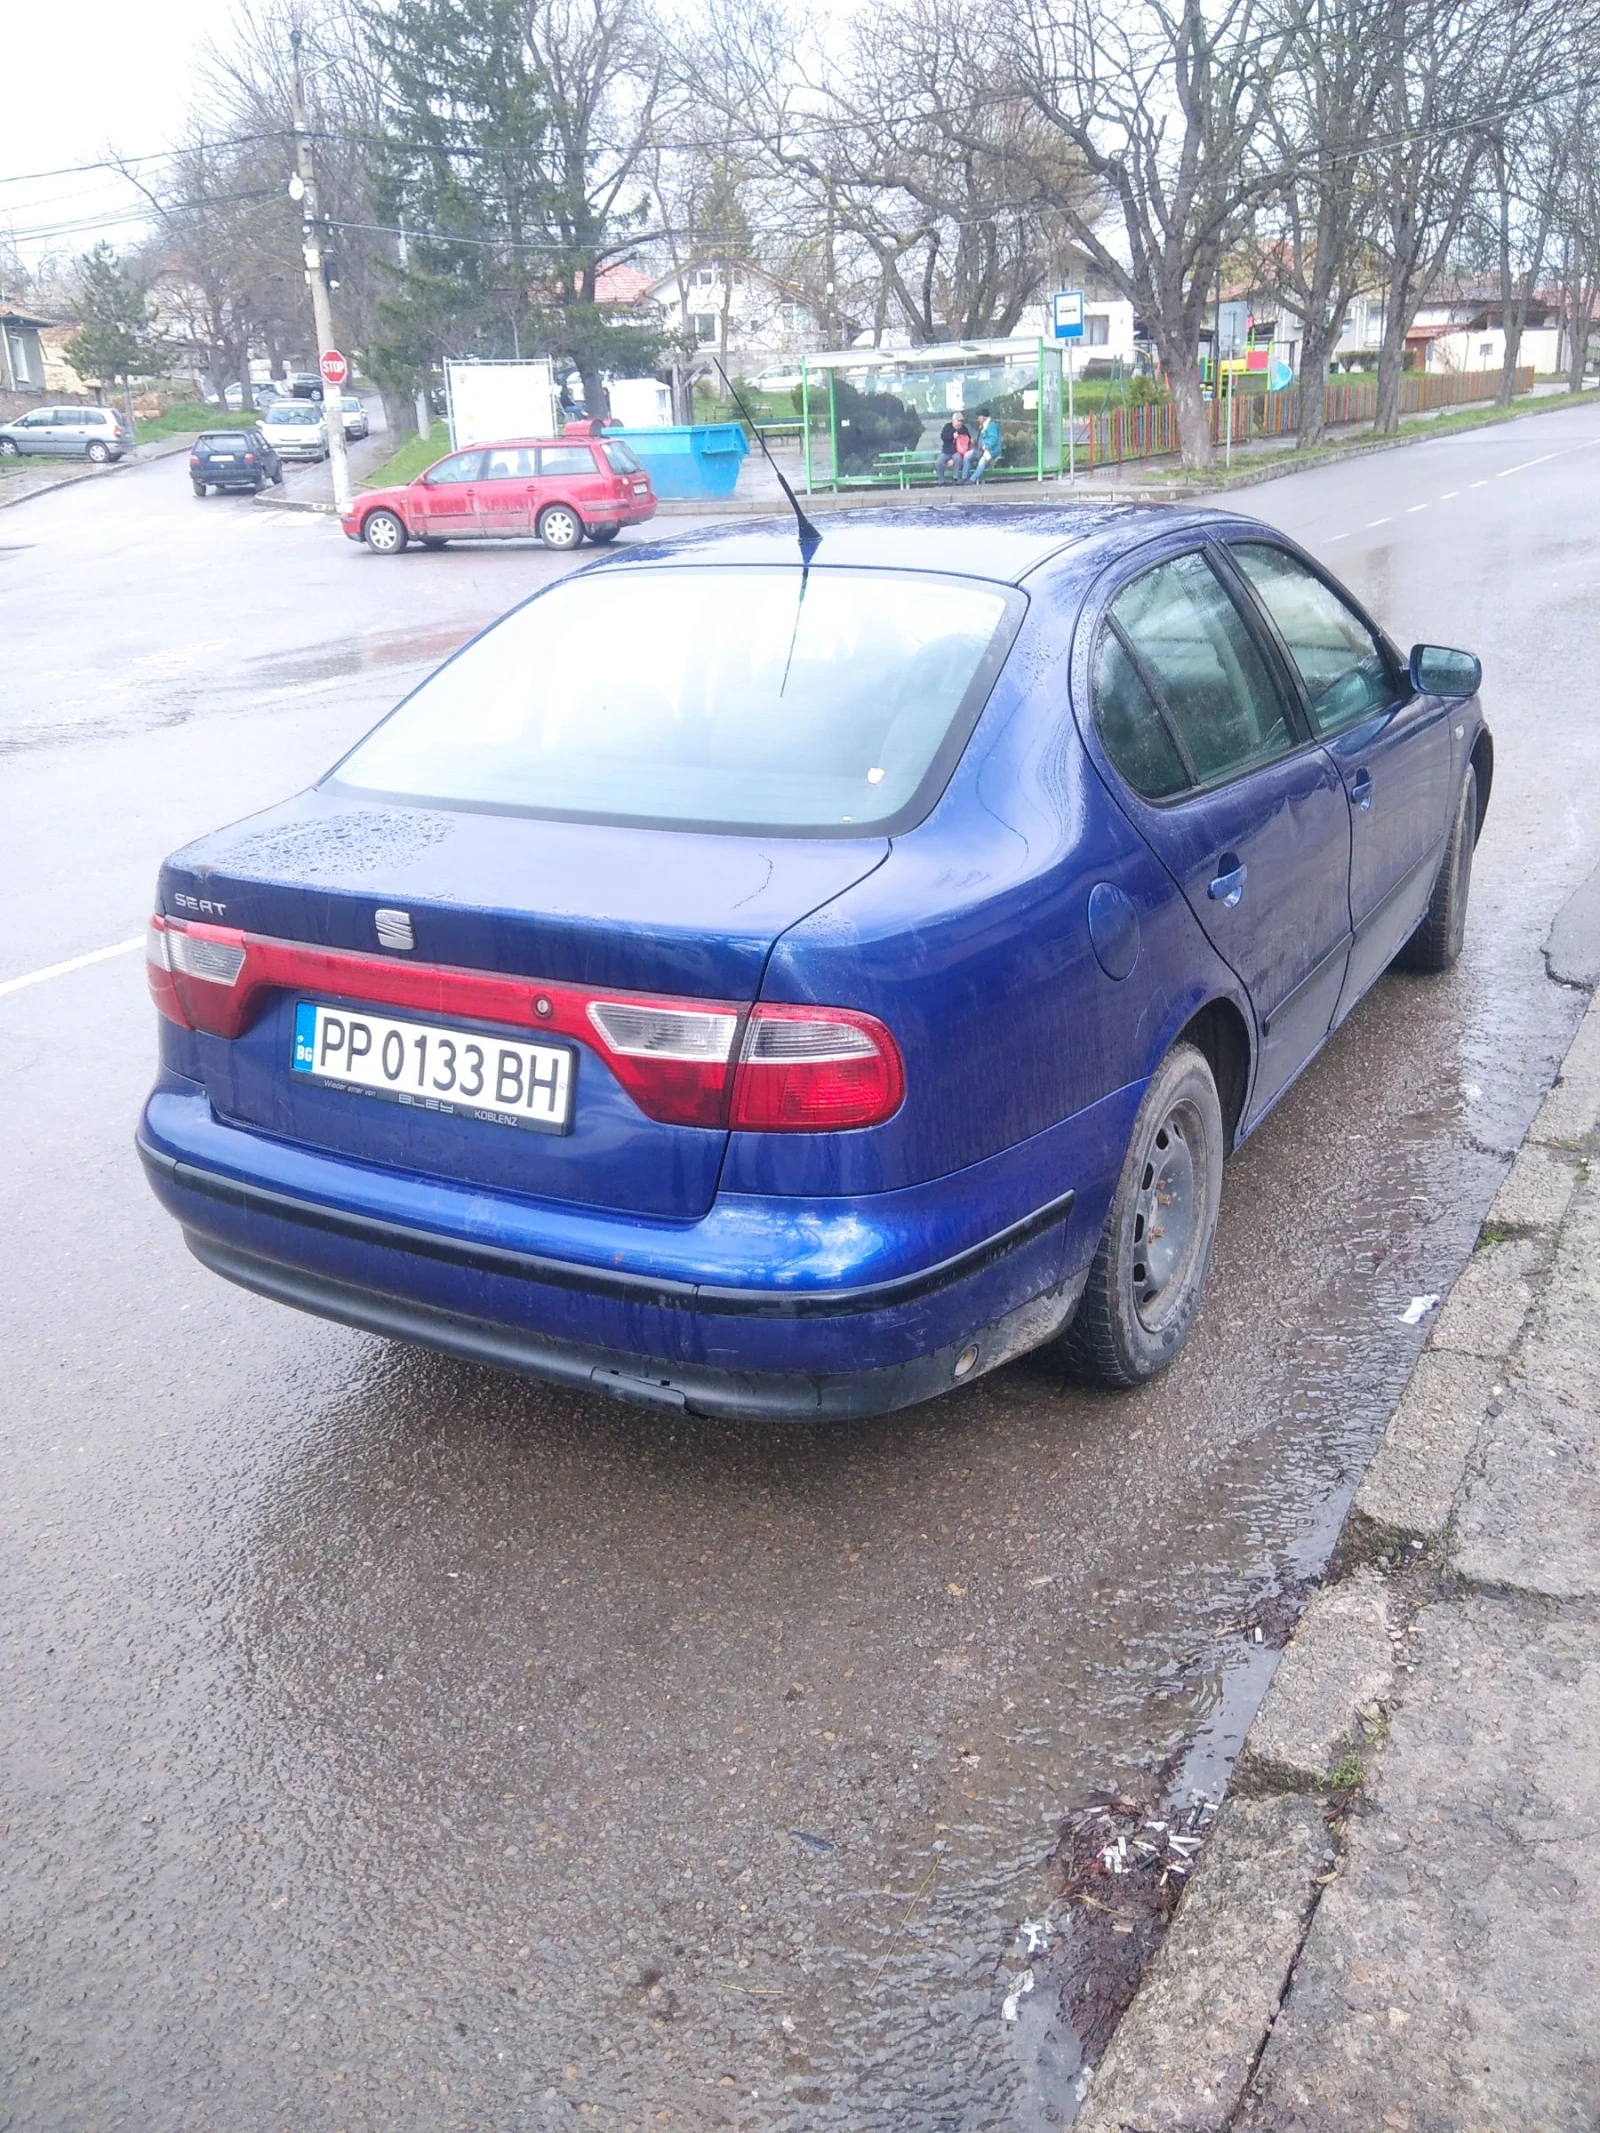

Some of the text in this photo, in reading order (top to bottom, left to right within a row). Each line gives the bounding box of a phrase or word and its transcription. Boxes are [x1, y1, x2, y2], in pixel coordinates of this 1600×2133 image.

[322, 360, 344, 373] STOP
[174, 892, 227, 916] SEAT
[296, 1045, 313, 1062] BG
[319, 1016, 559, 1112] PP 0133 BH
[324, 1079, 346, 1091] Wieder
[364, 1089, 377, 1098] von
[398, 1093, 455, 1115] BLEY
[474, 1109, 518, 1127] KOBLENZ
